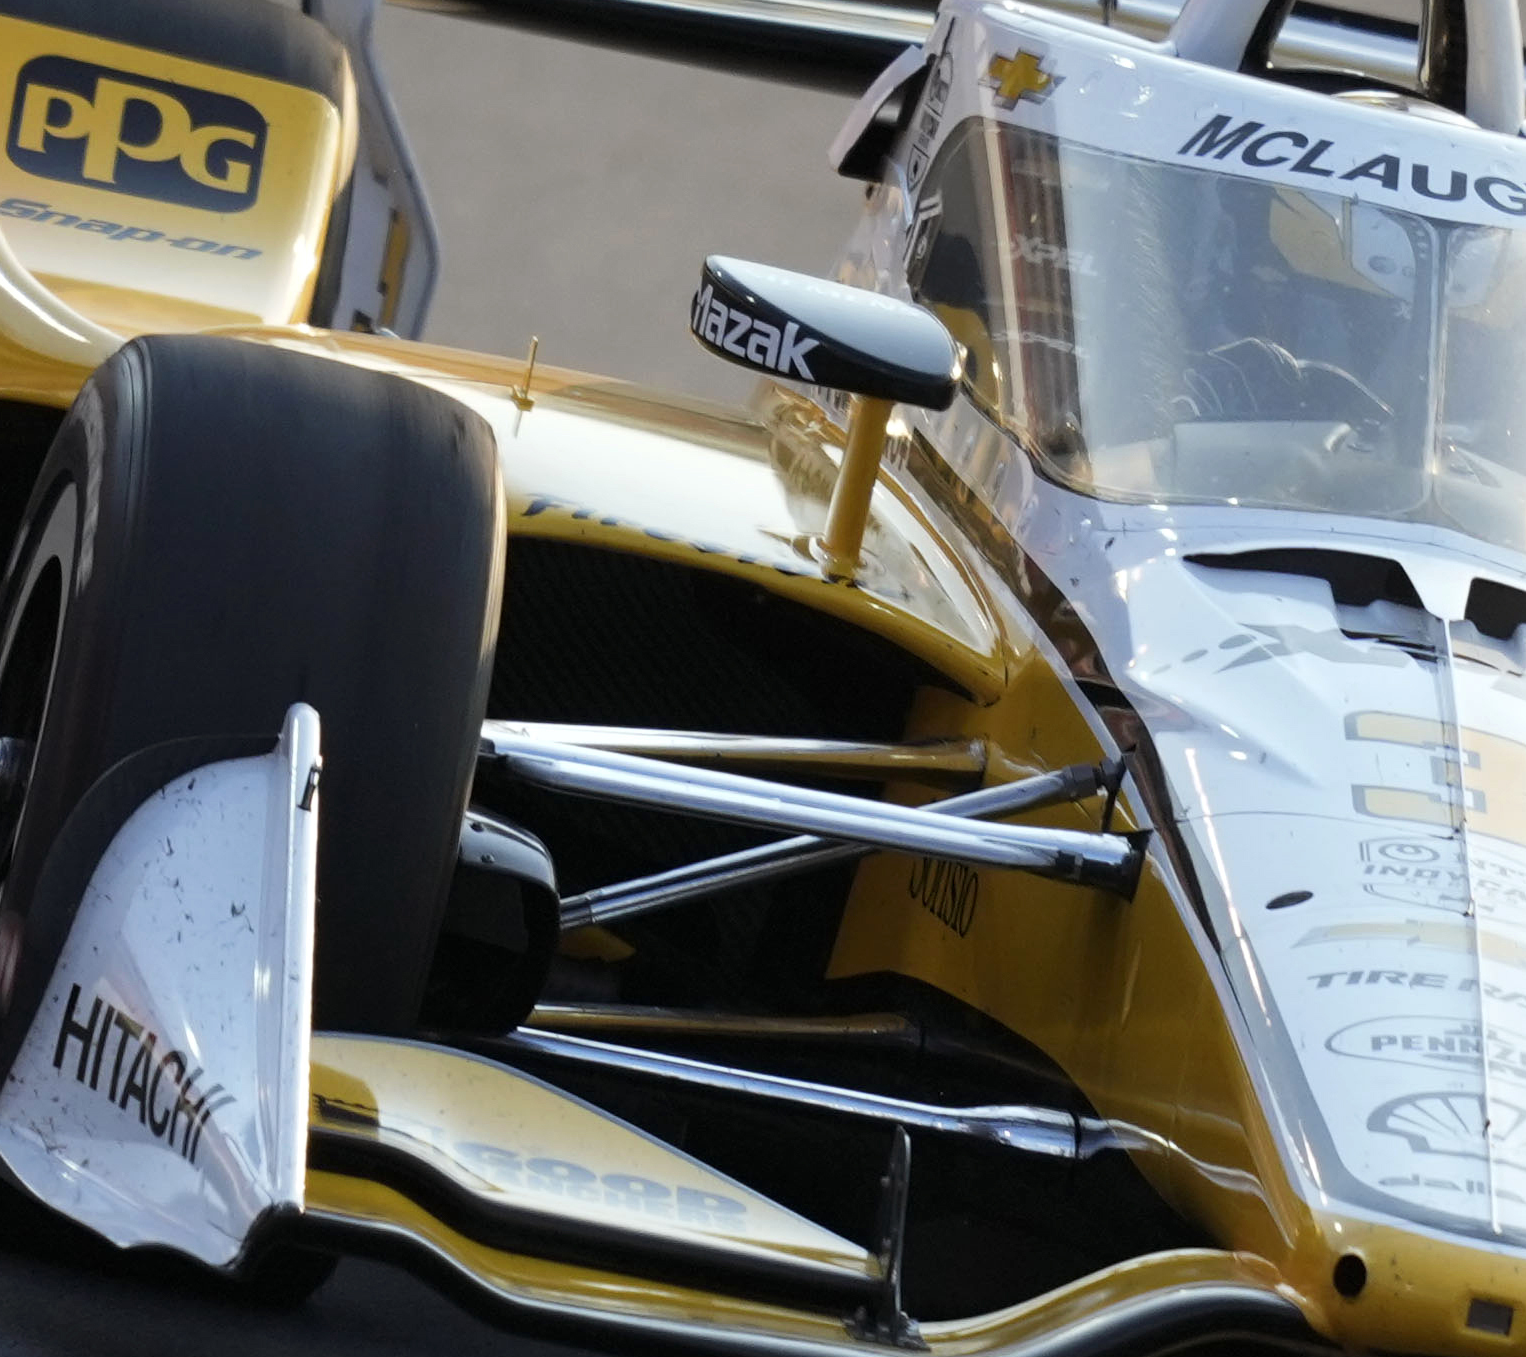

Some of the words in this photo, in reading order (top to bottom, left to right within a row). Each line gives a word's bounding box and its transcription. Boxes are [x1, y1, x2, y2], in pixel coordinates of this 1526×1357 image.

[16, 76, 257, 195] PPG
[692, 282, 821, 383] Mazak
[1306, 969, 1450, 991] TIRE
[52, 982, 238, 1165] HITACHI
